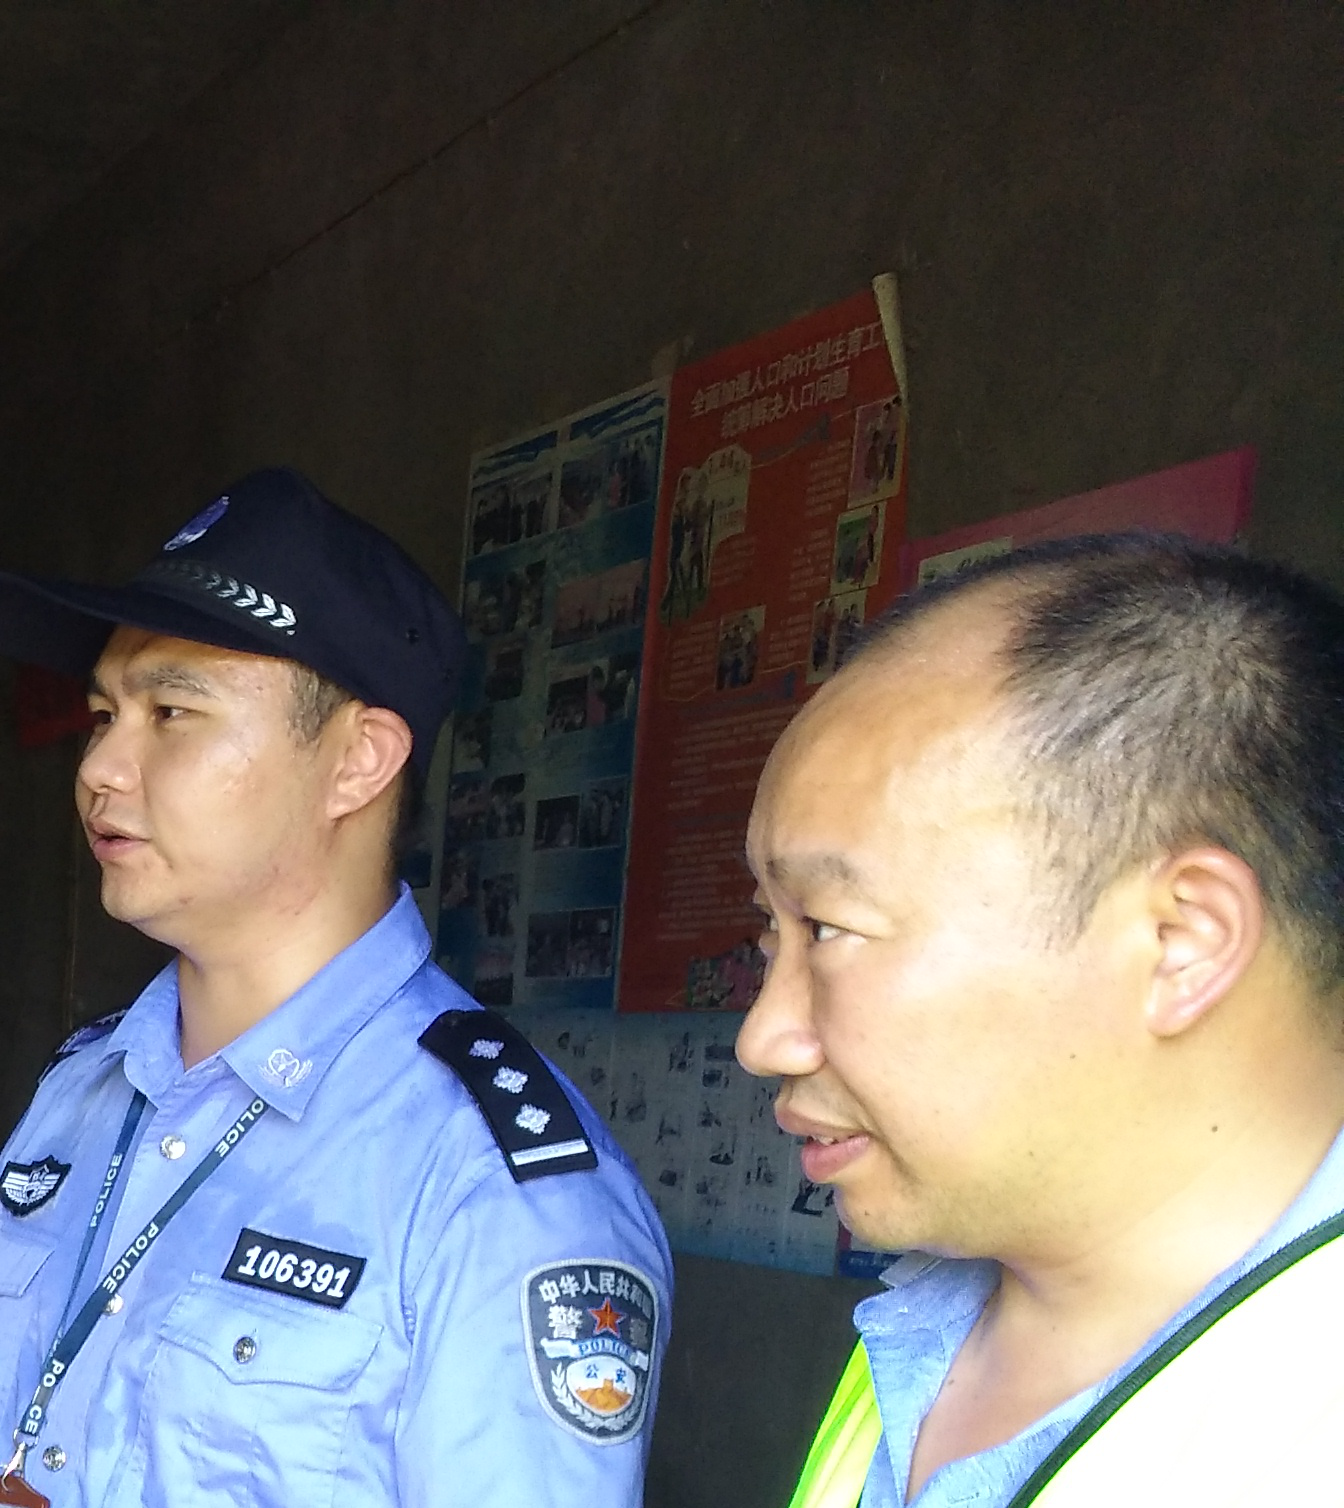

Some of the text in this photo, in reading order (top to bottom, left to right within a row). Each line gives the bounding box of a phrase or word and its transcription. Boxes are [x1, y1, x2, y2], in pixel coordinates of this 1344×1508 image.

[90, 1152, 123, 1228] POLICE
[101, 1221, 160, 1293] POLICE
[238, 1244, 351, 1299] 106391
